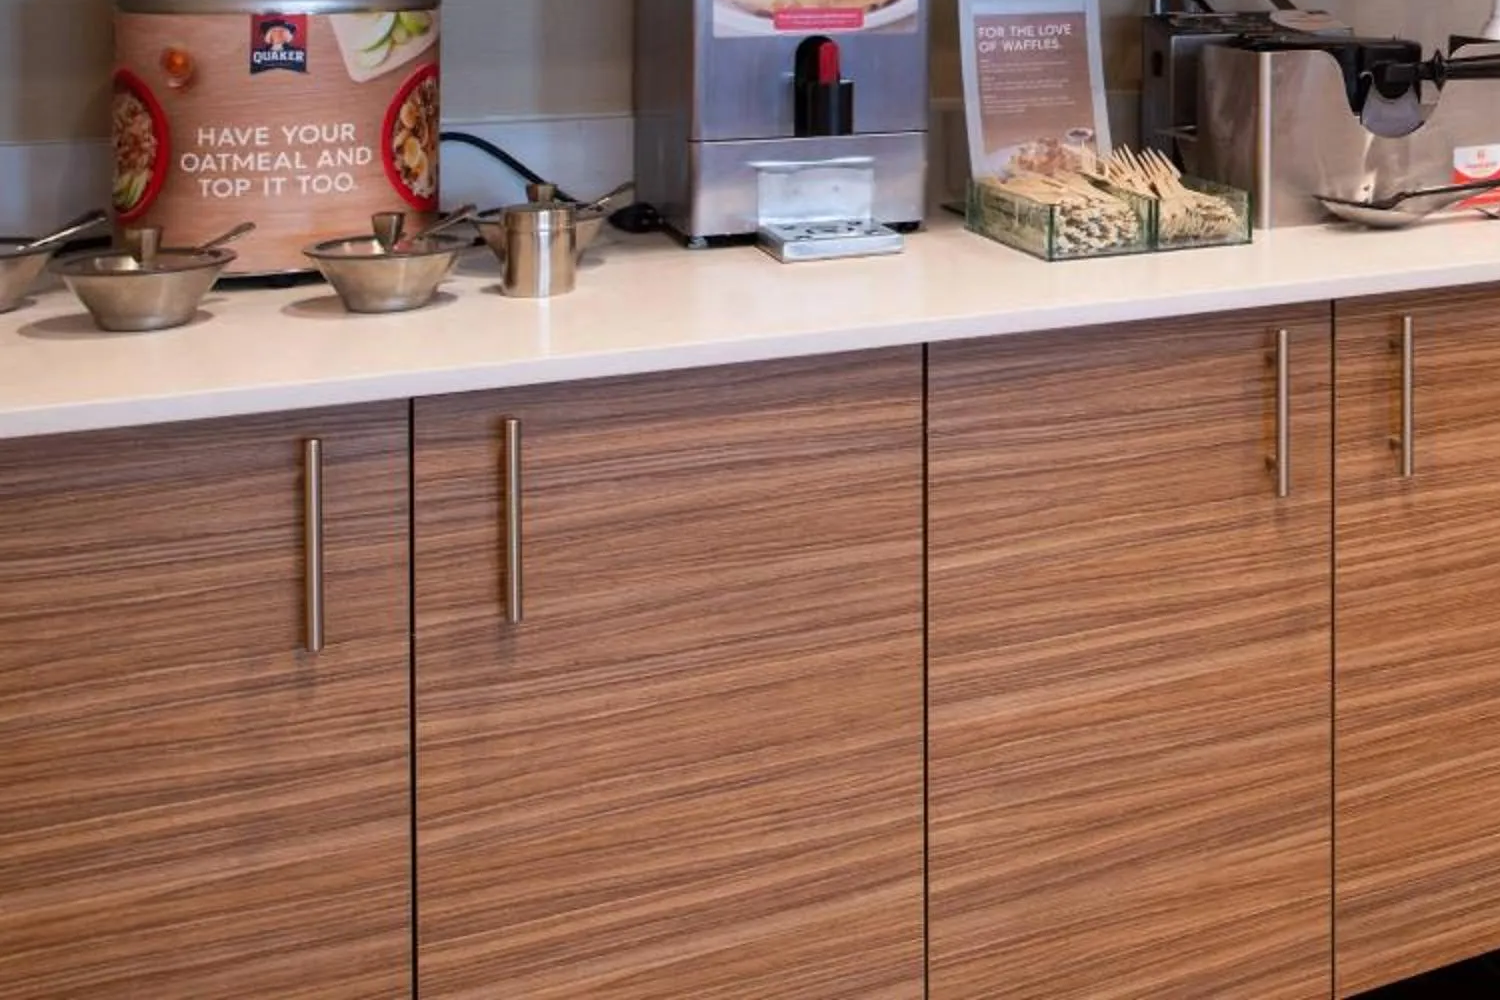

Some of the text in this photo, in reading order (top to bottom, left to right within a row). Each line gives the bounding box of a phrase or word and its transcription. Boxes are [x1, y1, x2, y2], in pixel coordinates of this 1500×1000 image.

[978, 23, 1073, 38] FOR THE LOVE
[979, 41, 997, 53] OF
[253, 51, 305, 64] QUAKER
[197, 123, 356, 147] HAVE YOUR
[180, 146, 372, 172] OATMEAL AND
[198, 178, 250, 198] TOP
[263, 176, 286, 196] IT
